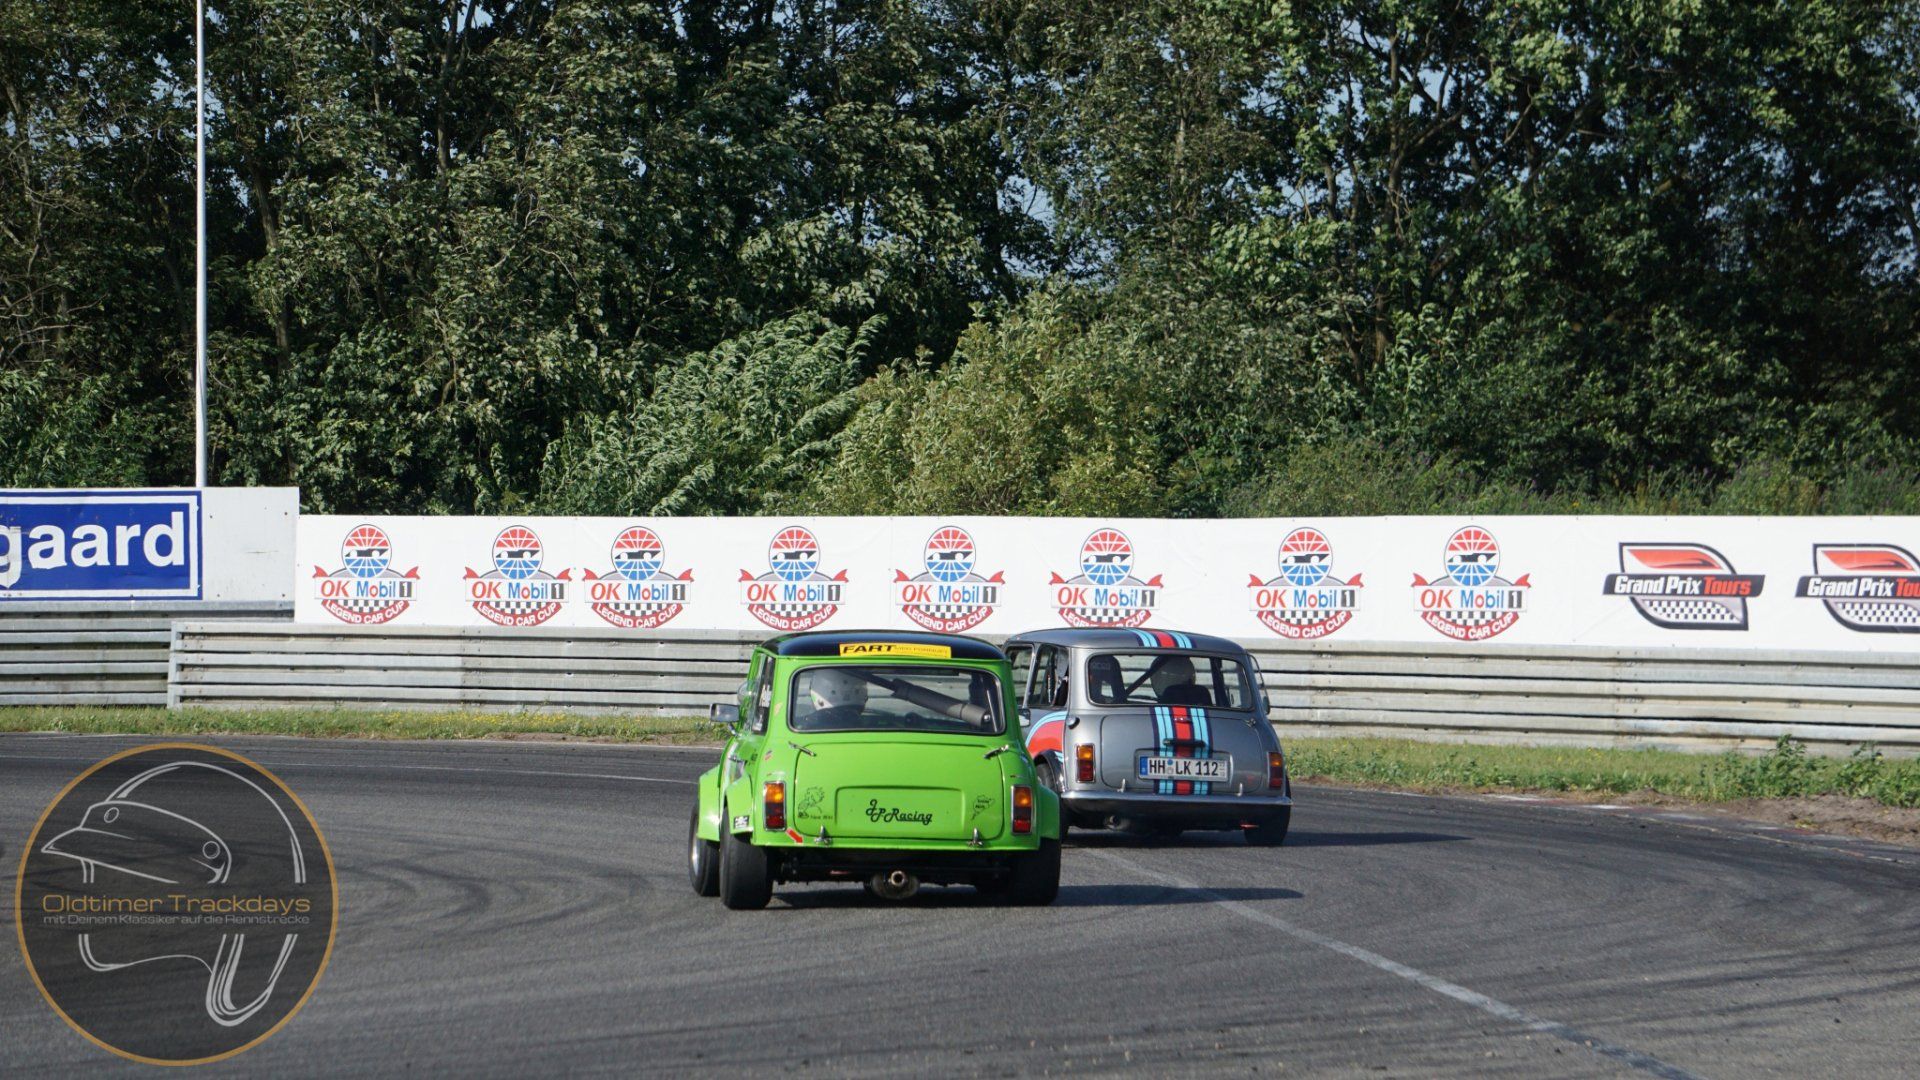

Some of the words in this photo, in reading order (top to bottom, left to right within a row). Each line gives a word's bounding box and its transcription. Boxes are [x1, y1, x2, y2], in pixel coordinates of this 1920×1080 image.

[321, 580, 350, 597] OK
[356, 581, 396, 597] Mobil
[471, 581, 502, 598] OK
[508, 582, 548, 599] Mobil
[591, 582, 621, 600] OK
[628, 583, 669, 600] Mobil
[747, 583, 778, 602] OK
[784, 584, 824, 602] Mobil
[902, 584, 932, 602] OK
[938, 585, 979, 603] Mobil
[1614, 575, 1665, 594] Grand
[1665, 575, 1702, 595] Prix
[1703, 576, 1752, 596] Tours
[1807, 577, 1858, 596] Grand
[1858, 578, 1894, 597] Prix
[1057, 587, 1088, 606] OK
[1095, 588, 1138, 607] Mobil
[1256, 589, 1287, 608] OK
[1294, 589, 1337, 608] Mobil
[1421, 589, 1453, 608] OK
[1460, 590, 1504, 608] Mobil
[325, 600, 362, 623] LEGEND
[364, 613, 384, 624] CAR
[384, 600, 405, 617] CUP
[477, 601, 514, 625] LEGEND
[516, 615, 536, 626] CAR
[537, 602, 557, 619] CUP
[596, 603, 634, 627] LEGEND
[636, 617, 656, 628] CAR
[658, 603, 678, 620] CUP
[752, 604, 789, 629] LEGEND
[791, 618, 811, 629] CAR
[813, 604, 833, 623] CUP
[907, 606, 944, 630] LEGEND
[945, 620, 966, 631] CAR
[968, 606, 988, 625] CUP
[1261, 611, 1300, 637] LEGEND
[1302, 625, 1324, 638] CAR
[1325, 611, 1347, 631] CUP
[1426, 612, 1466, 637] LEGEND
[1467, 626, 1491, 639] CAR
[1491, 612, 1514, 632] CUP
[843, 645, 896, 654] FART
[1149, 759, 1166, 774] HH
[1175, 760, 1191, 775] LK
[1195, 761, 1219, 776] 112
